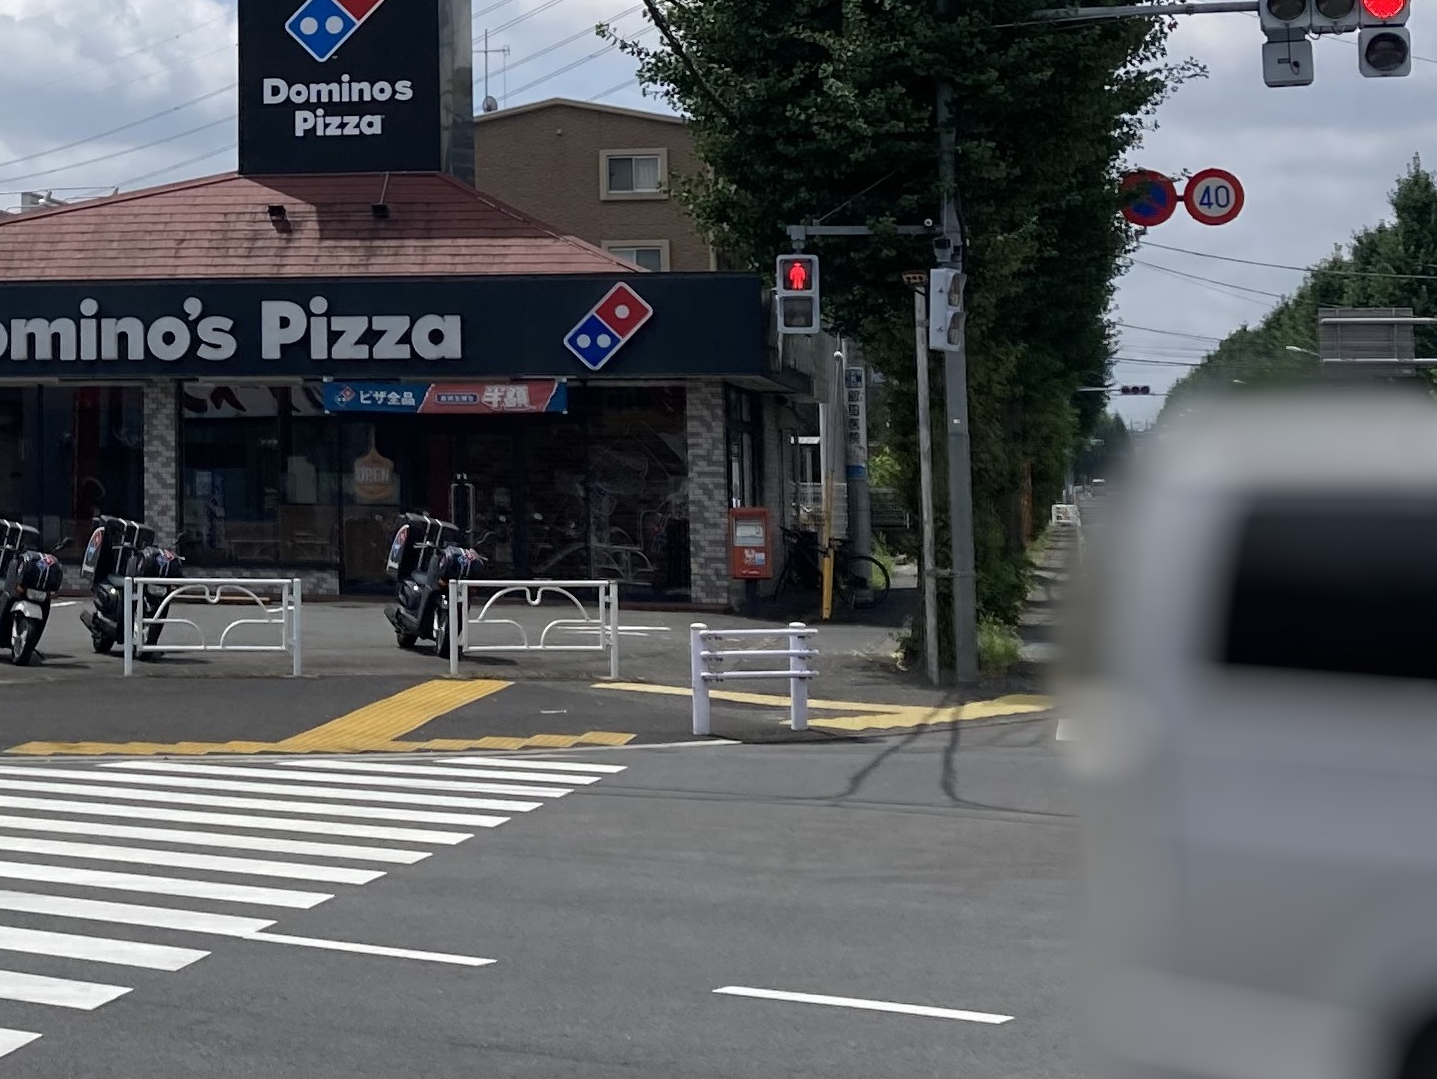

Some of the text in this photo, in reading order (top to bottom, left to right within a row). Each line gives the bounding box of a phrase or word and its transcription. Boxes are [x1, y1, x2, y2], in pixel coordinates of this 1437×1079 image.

[263, 74, 413, 104] Dominos
[294, 108, 382, 137] Pizza
[1199, 185, 1230, 209] 40
[261, 296, 462, 360] Pizza
[359, 389, 416, 406] ピザ全品
